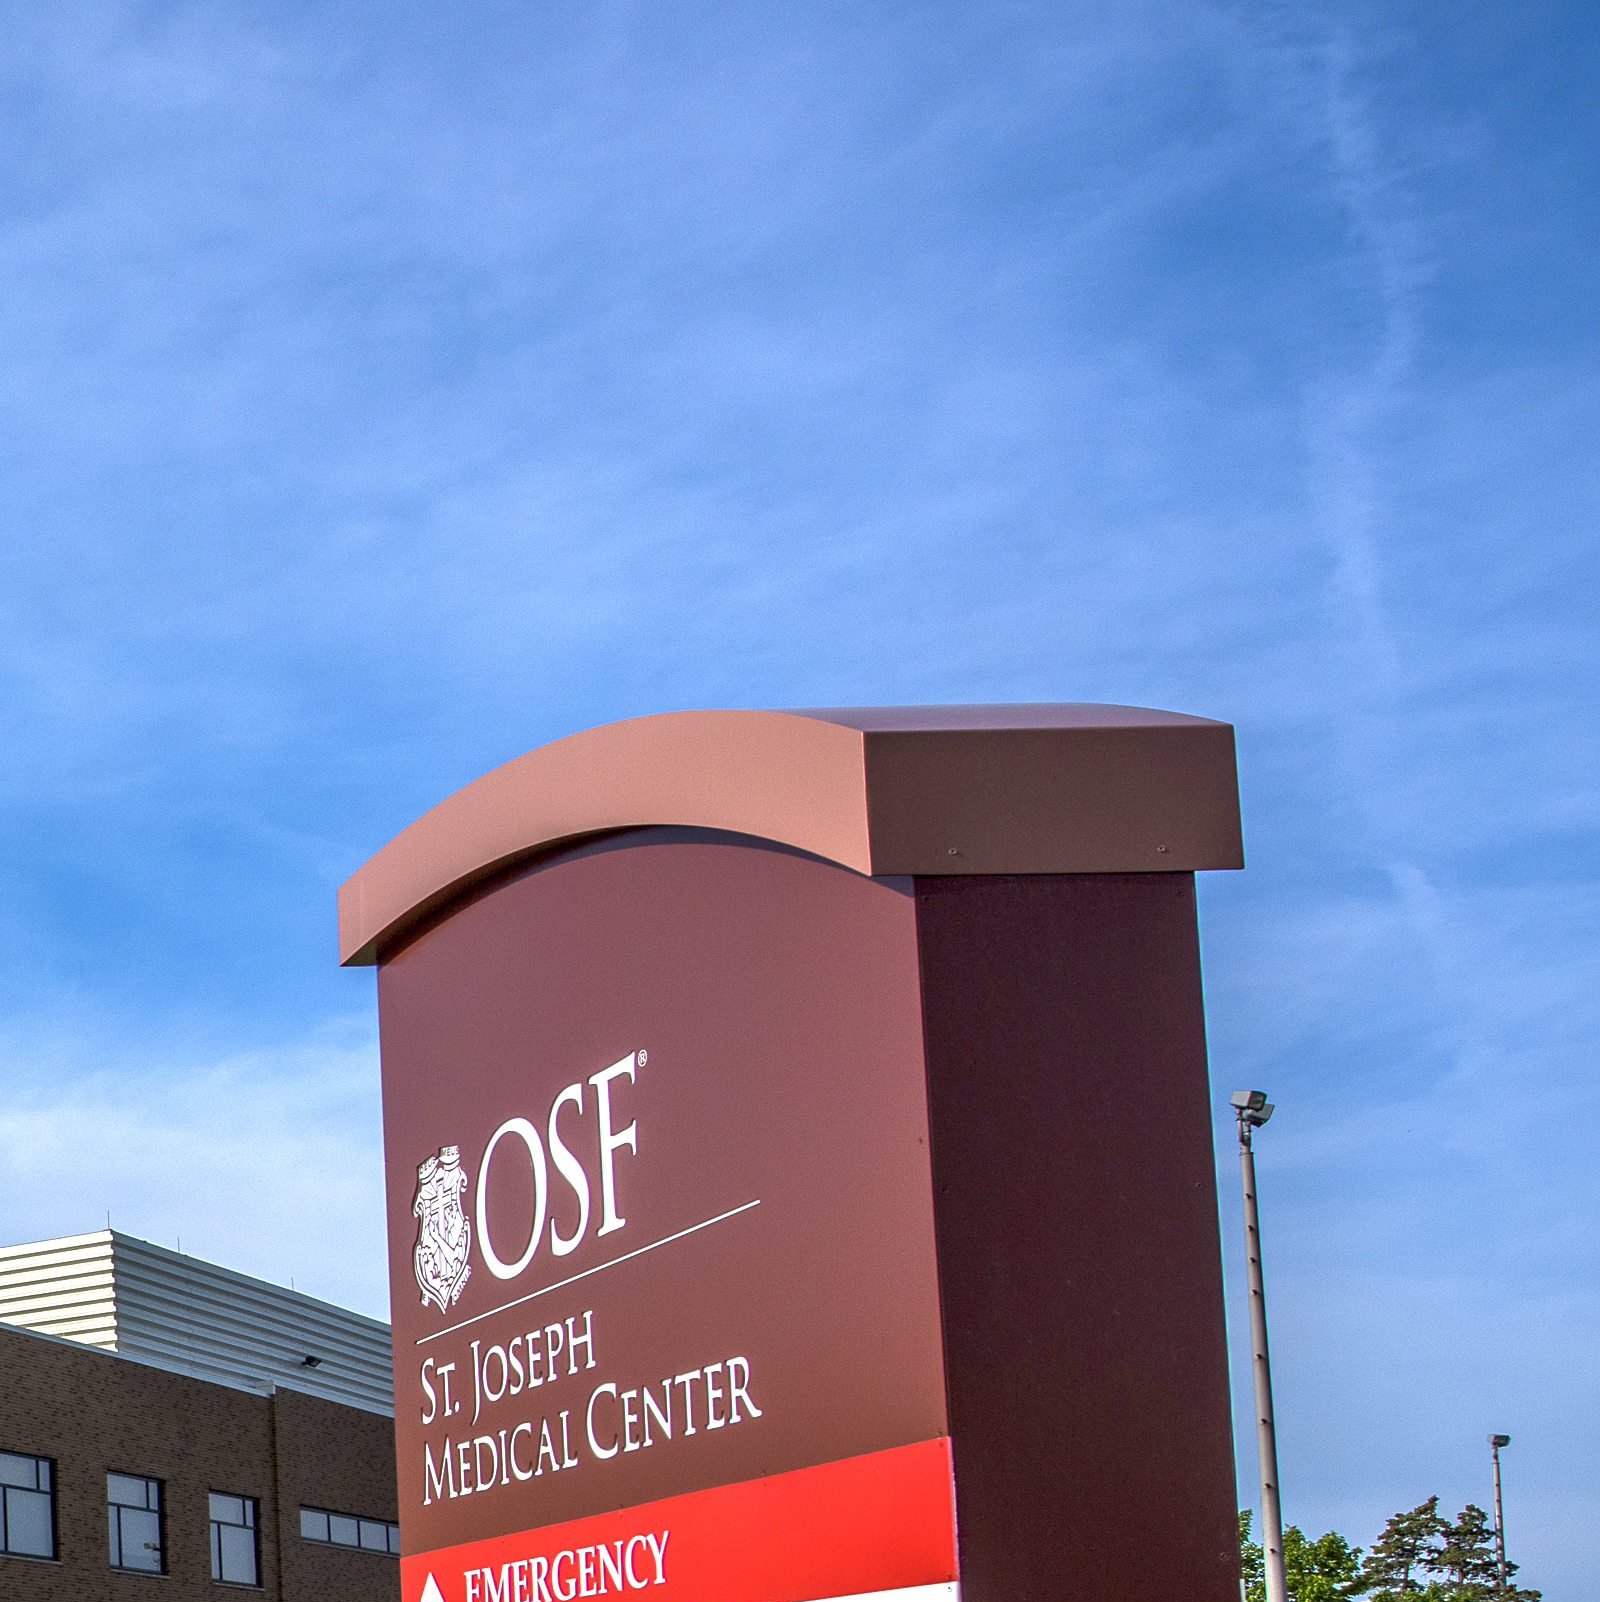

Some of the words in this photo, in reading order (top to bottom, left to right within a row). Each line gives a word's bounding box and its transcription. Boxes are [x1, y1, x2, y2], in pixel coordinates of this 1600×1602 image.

[420, 1357, 460, 1424] ST.
[471, 1310, 596, 1425] JOSEPH
[424, 1410, 578, 1505] MEDICAL
[586, 1355, 762, 1460] CENTER
